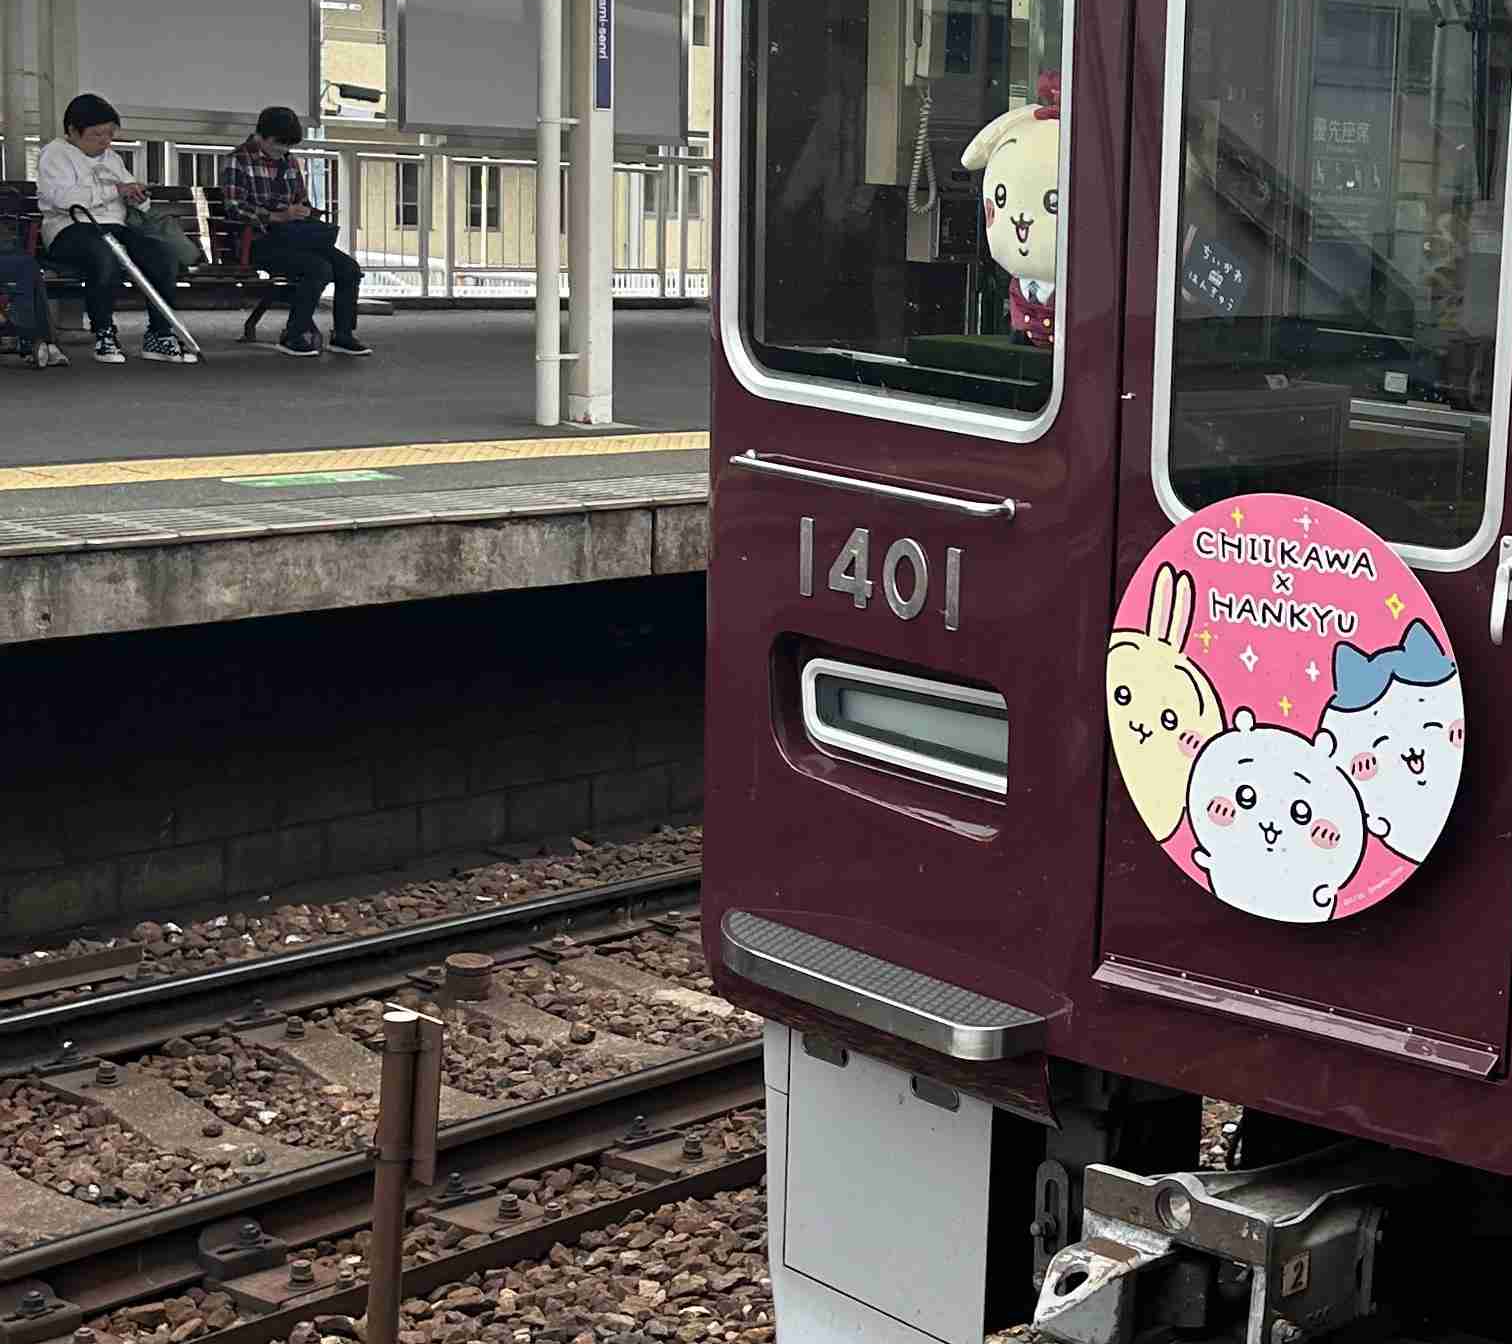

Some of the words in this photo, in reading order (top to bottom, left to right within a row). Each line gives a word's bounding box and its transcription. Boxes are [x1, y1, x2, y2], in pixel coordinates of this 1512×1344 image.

[800, 516, 966, 631] 1401
[1195, 530, 1375, 577] CHIIKAWA
[1211, 592, 1356, 634] HANKYU
[1291, 1258, 1305, 1290] 2
